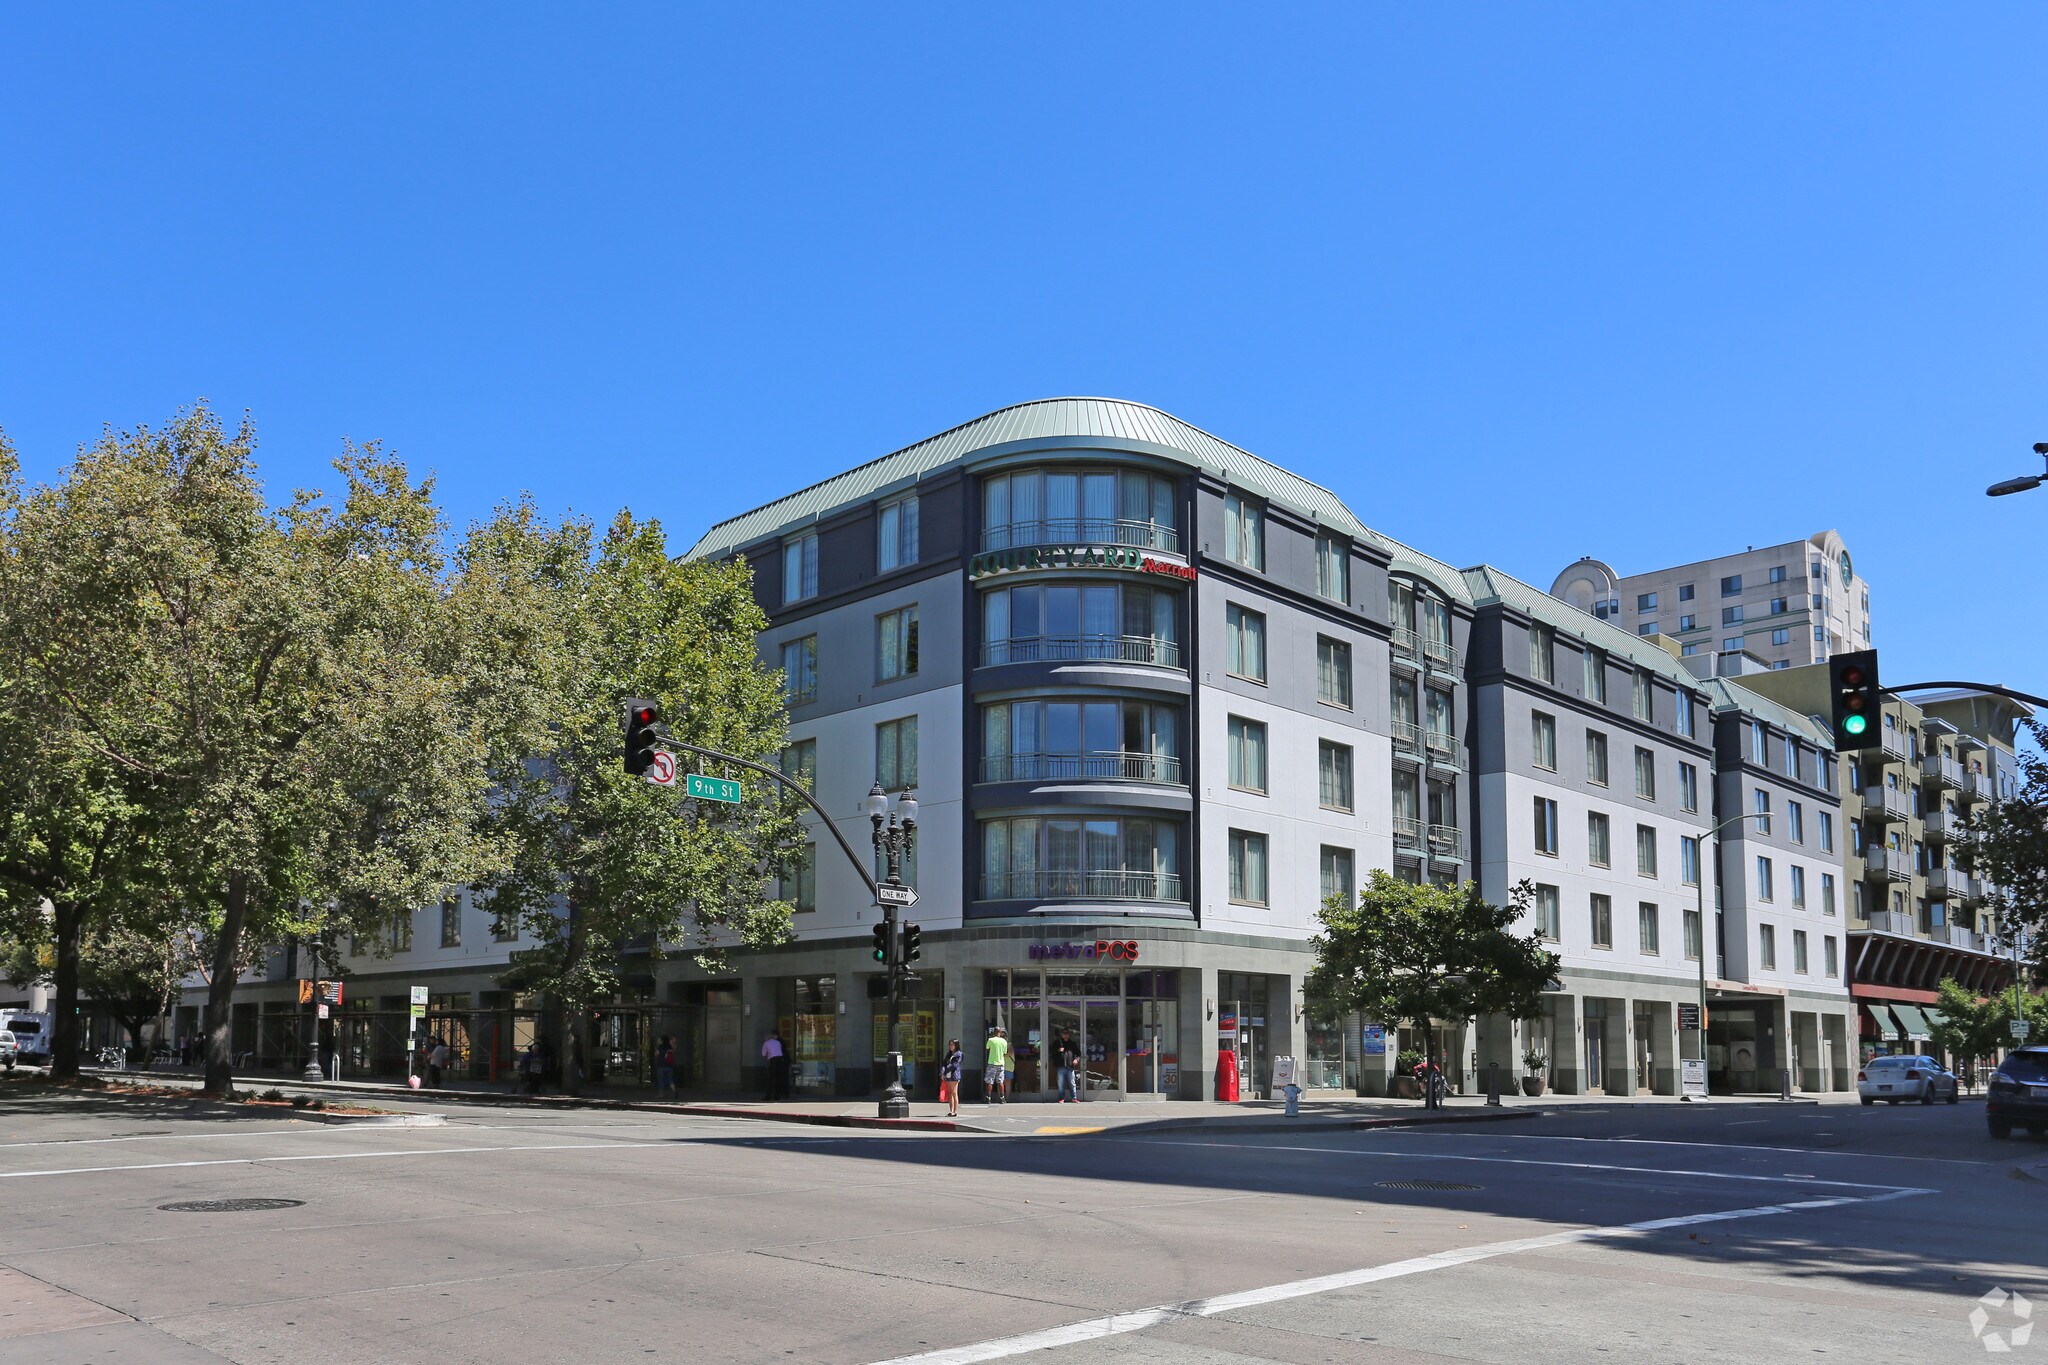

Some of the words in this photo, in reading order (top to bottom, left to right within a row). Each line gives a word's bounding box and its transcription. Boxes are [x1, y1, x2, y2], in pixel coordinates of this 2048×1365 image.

[969, 546, 1141, 577] COURTYARD
[1141, 557, 1197, 581] Marriott
[695, 780, 715, 795] 9th
[721, 784, 734, 798] St
[881, 890, 895, 899] ONE
[895, 891, 908, 900] WAY
[1029, 940, 1139, 961] metroPCS
